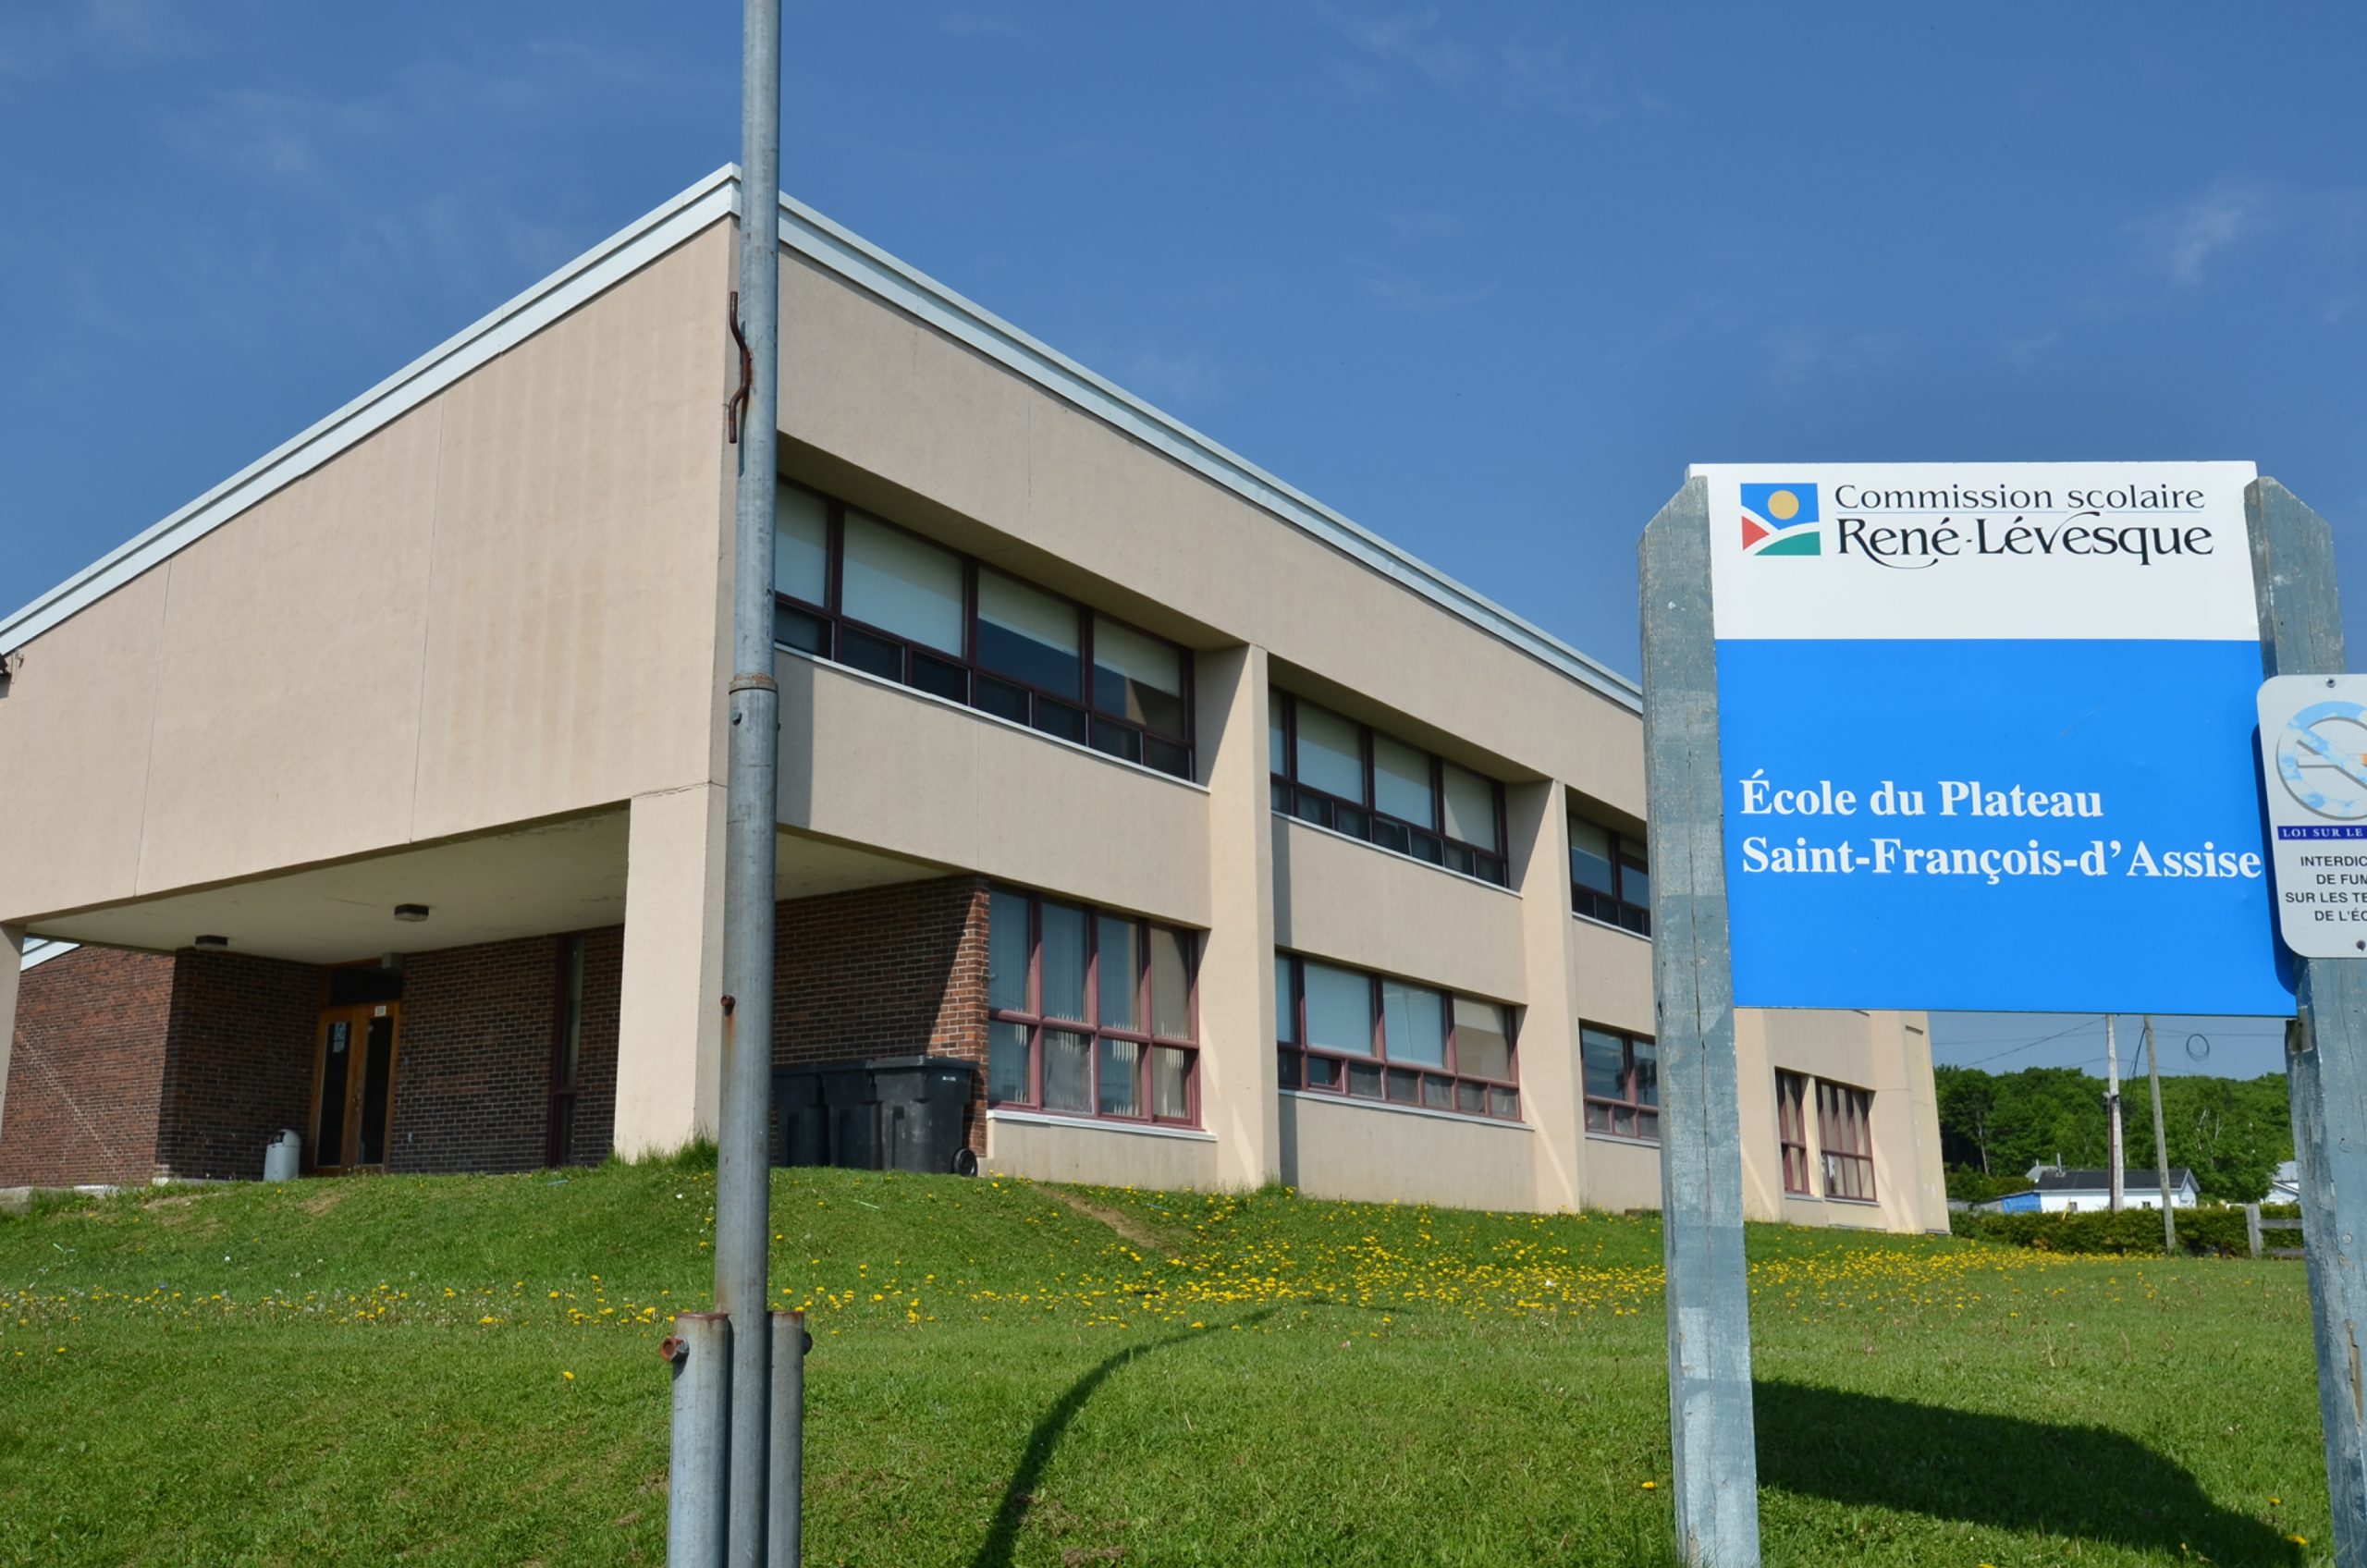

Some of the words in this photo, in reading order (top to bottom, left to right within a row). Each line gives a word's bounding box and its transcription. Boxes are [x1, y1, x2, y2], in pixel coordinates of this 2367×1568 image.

[1835, 484, 2053, 508] Commission
[2067, 484, 2205, 508] scolaire
[1739, 768, 1857, 815] École
[1870, 780, 1926, 815] du
[1938, 780, 2103, 817] Plateau
[2283, 828, 2307, 837] LOI
[2313, 828, 2340, 837] SUR
[2347, 828, 2362, 837] LE
[2300, 856, 2367, 866] INTERDIC
[2316, 875, 2336, 885] DE
[2286, 892, 2315, 902] SUR
[2320, 892, 2348, 902] LES
[2314, 911, 2335, 921] DE
